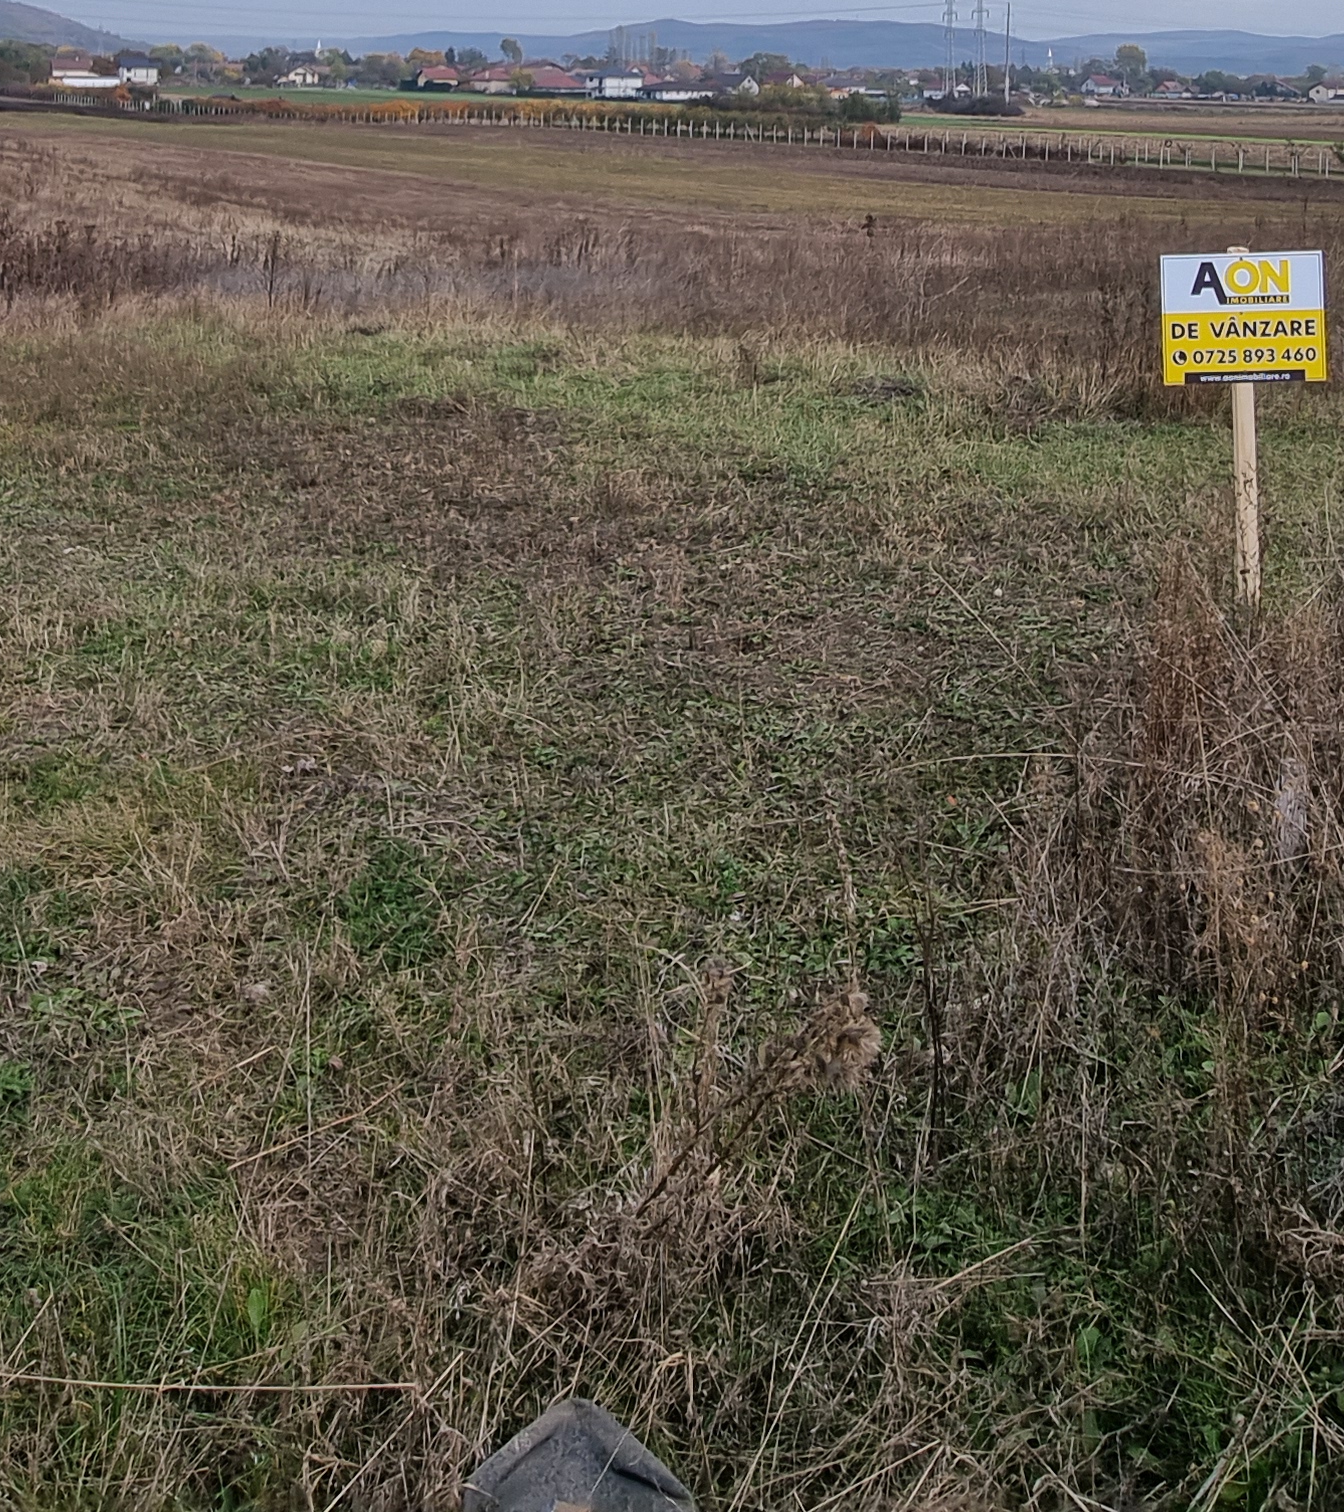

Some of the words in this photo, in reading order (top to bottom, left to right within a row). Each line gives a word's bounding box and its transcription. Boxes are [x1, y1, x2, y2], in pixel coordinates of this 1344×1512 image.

[1191, 260, 1290, 305] AON
[1226, 296, 1289, 304] IMOBILIARE
[1171, 323, 1199, 339] DE
[1210, 317, 1316, 338] VÂNZARE
[1193, 350, 1237, 364] 0725
[1243, 349, 1275, 362] 893
[1281, 348, 1316, 362] 460
